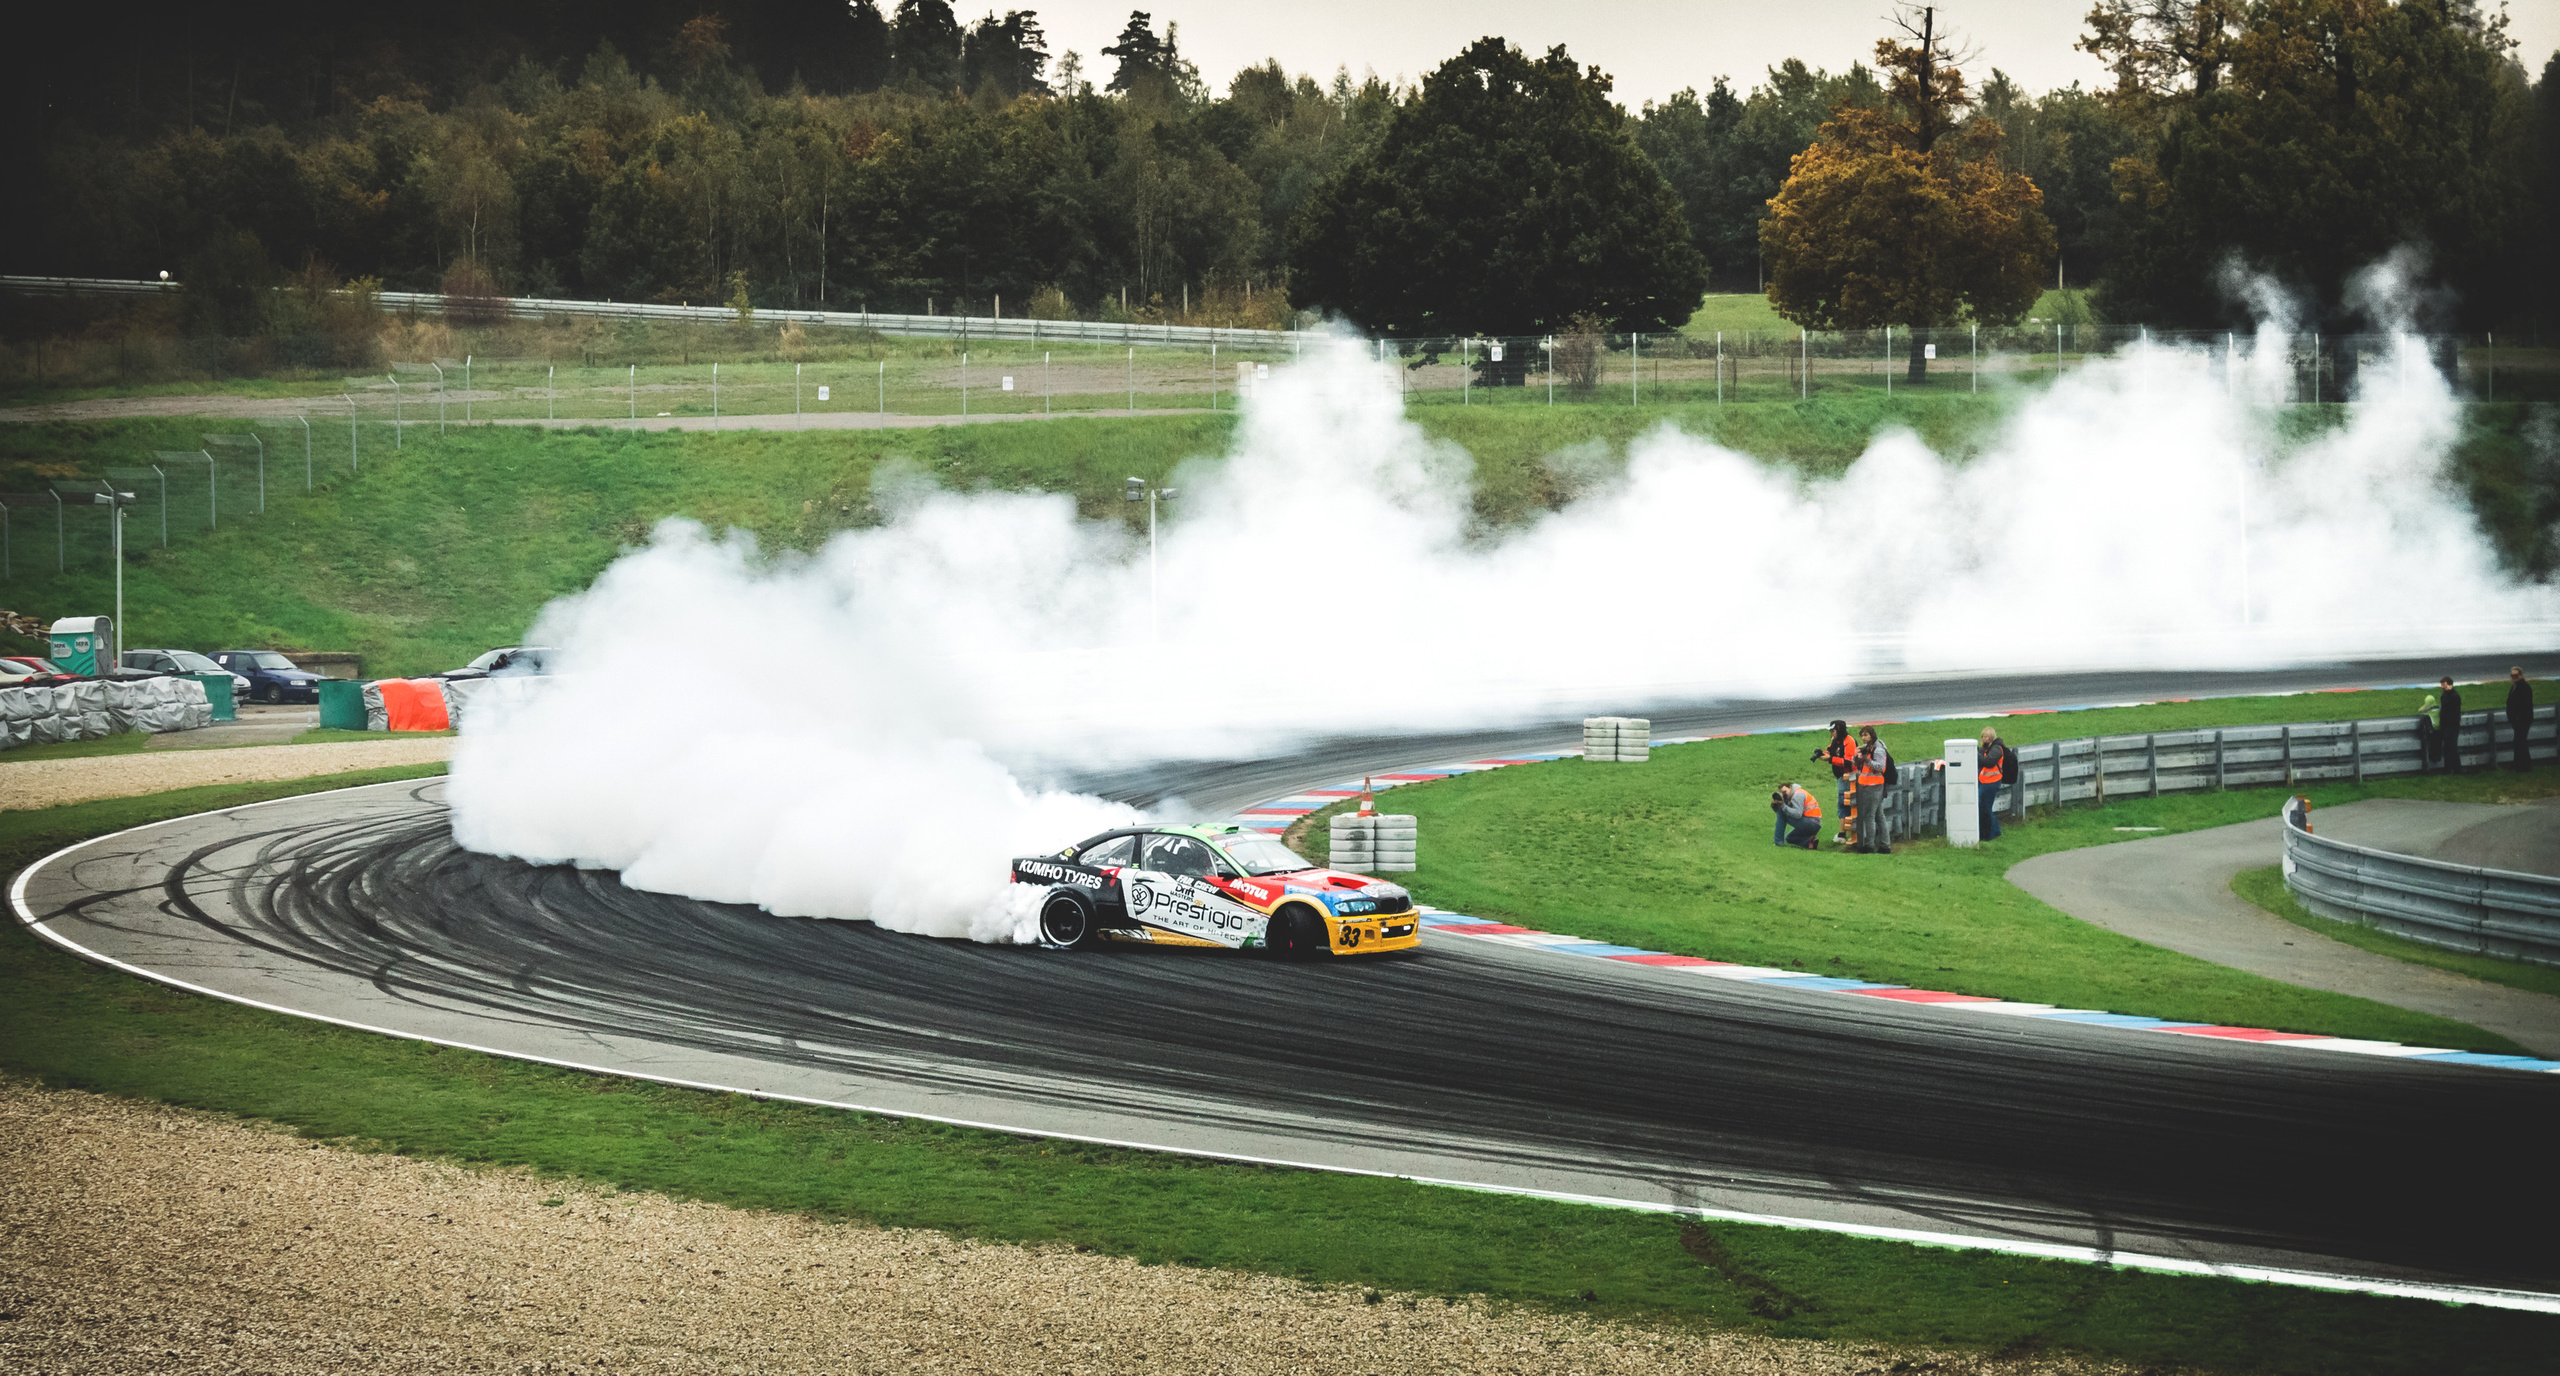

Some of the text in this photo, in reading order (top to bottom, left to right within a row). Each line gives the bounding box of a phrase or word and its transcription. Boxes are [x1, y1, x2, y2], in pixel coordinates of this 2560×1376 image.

[1018, 859, 1063, 880] KUMHO
[1064, 868, 1103, 889] TYRES
[1176, 874, 1220, 894] FAIL CREW
[1170, 890, 1194, 902] MASTERS
[1175, 883, 1195, 897] Drift
[1229, 879, 1269, 900] MOTUL
[1154, 892, 1242, 930] Prestigio
[1153, 914, 1169, 923] THE
[1172, 919, 1190, 928] ART
[1207, 928, 1242, 942] HI-TECH
[1339, 925, 1361, 947] 33
